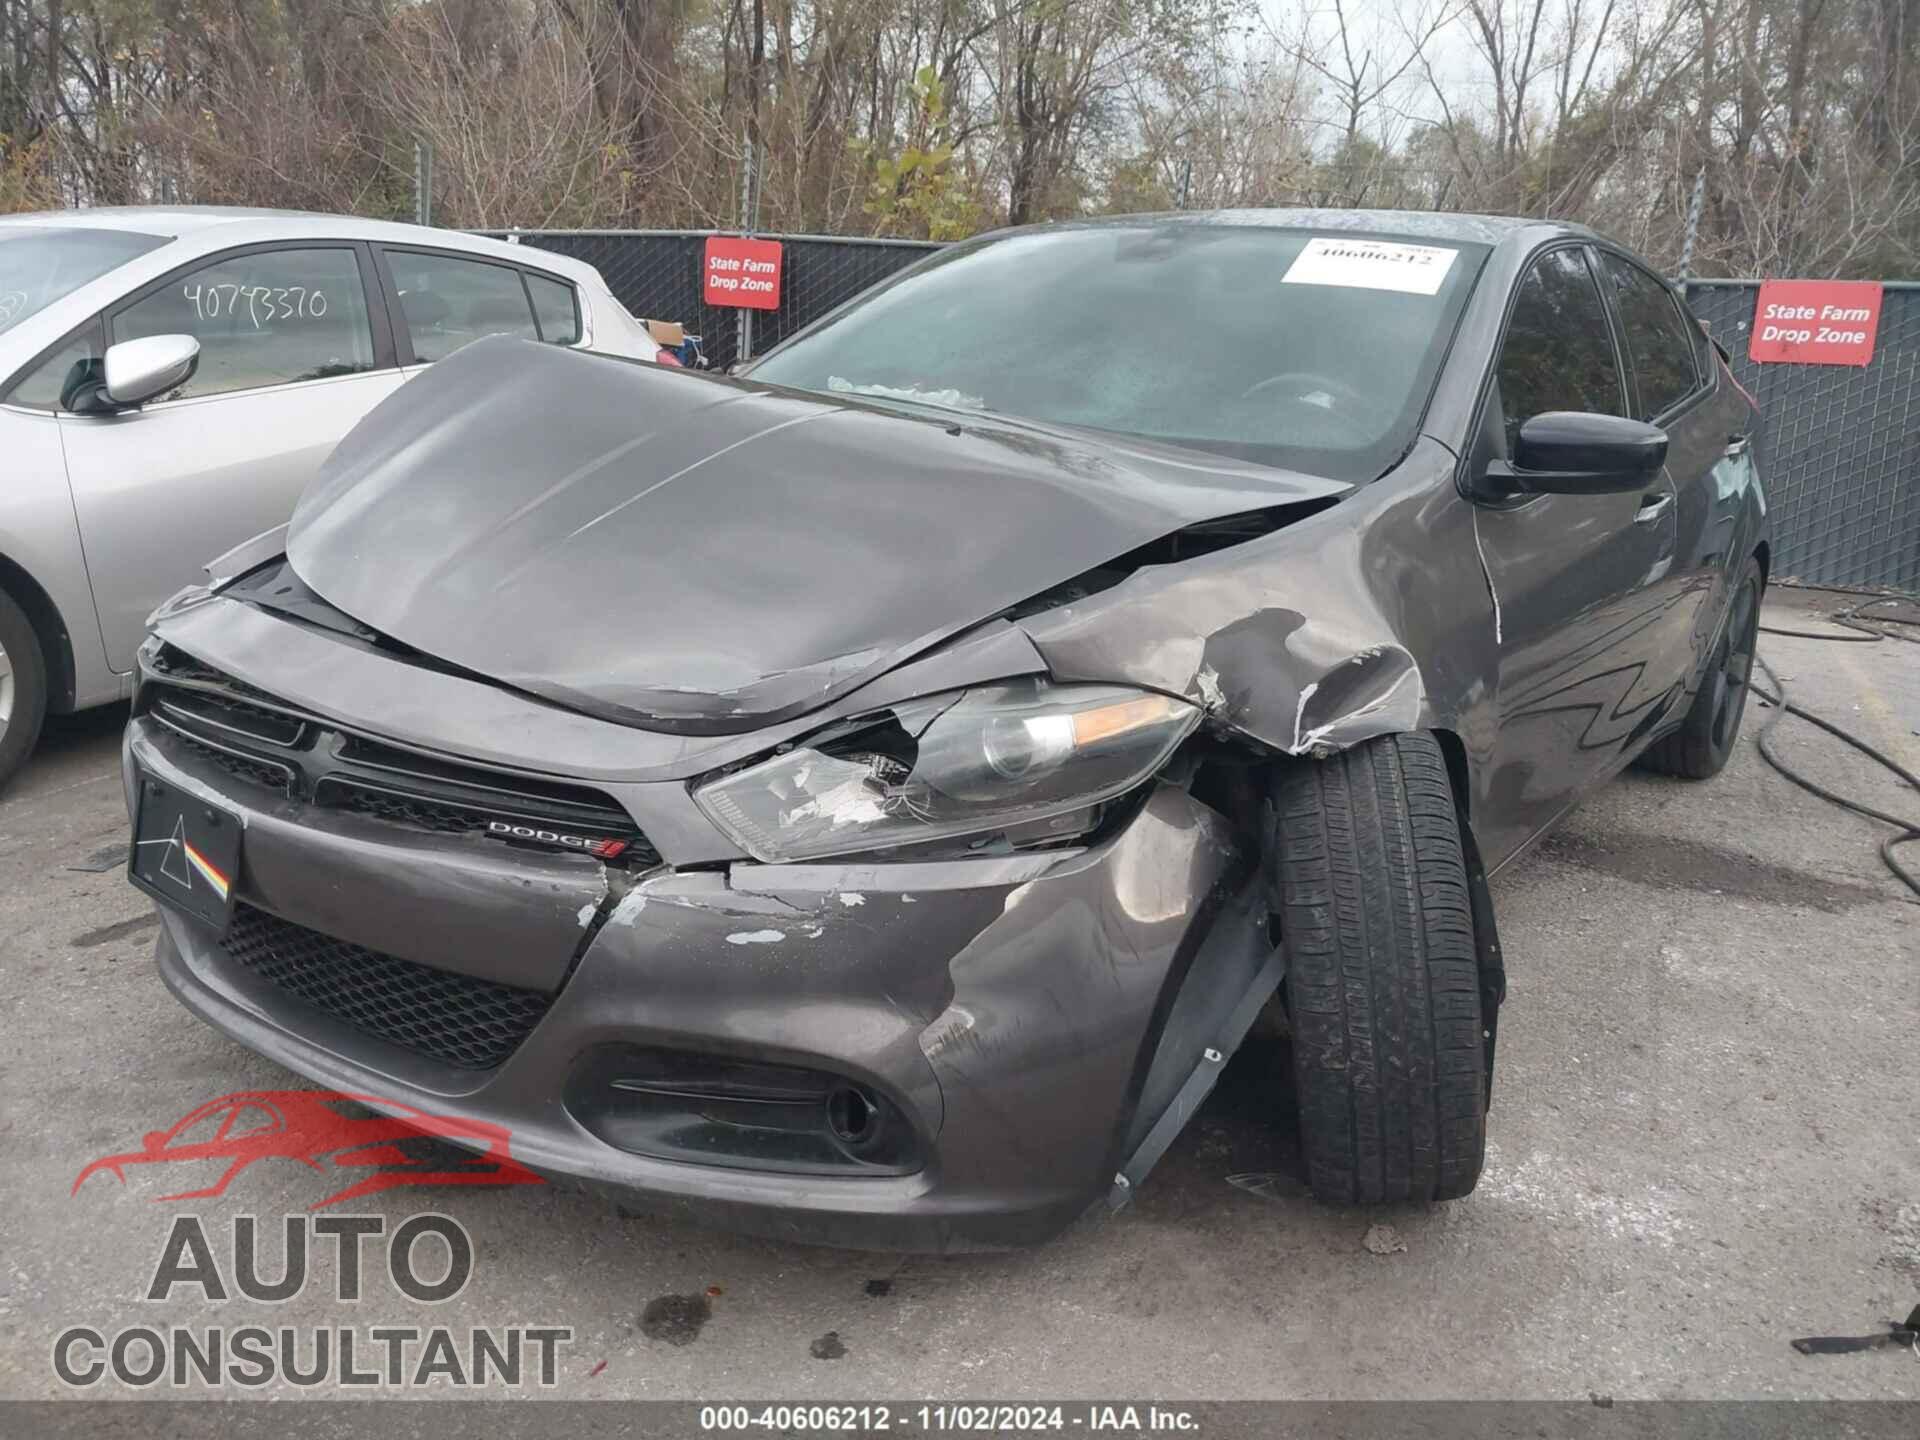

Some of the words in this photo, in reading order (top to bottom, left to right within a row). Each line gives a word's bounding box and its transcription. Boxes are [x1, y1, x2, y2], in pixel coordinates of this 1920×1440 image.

[709, 256, 740, 271] State
[743, 258, 776, 273] Farm
[710, 275, 738, 292] Drop
[740, 276, 774, 292] Zone
[184, 284, 327, 328] 40743370
[1764, 304, 1816, 319] State
[1820, 305, 1871, 321] Farm
[1762, 326, 1811, 344] Drop
[1815, 327, 1866, 344] Zone
[489, 821, 606, 849] DODGE
